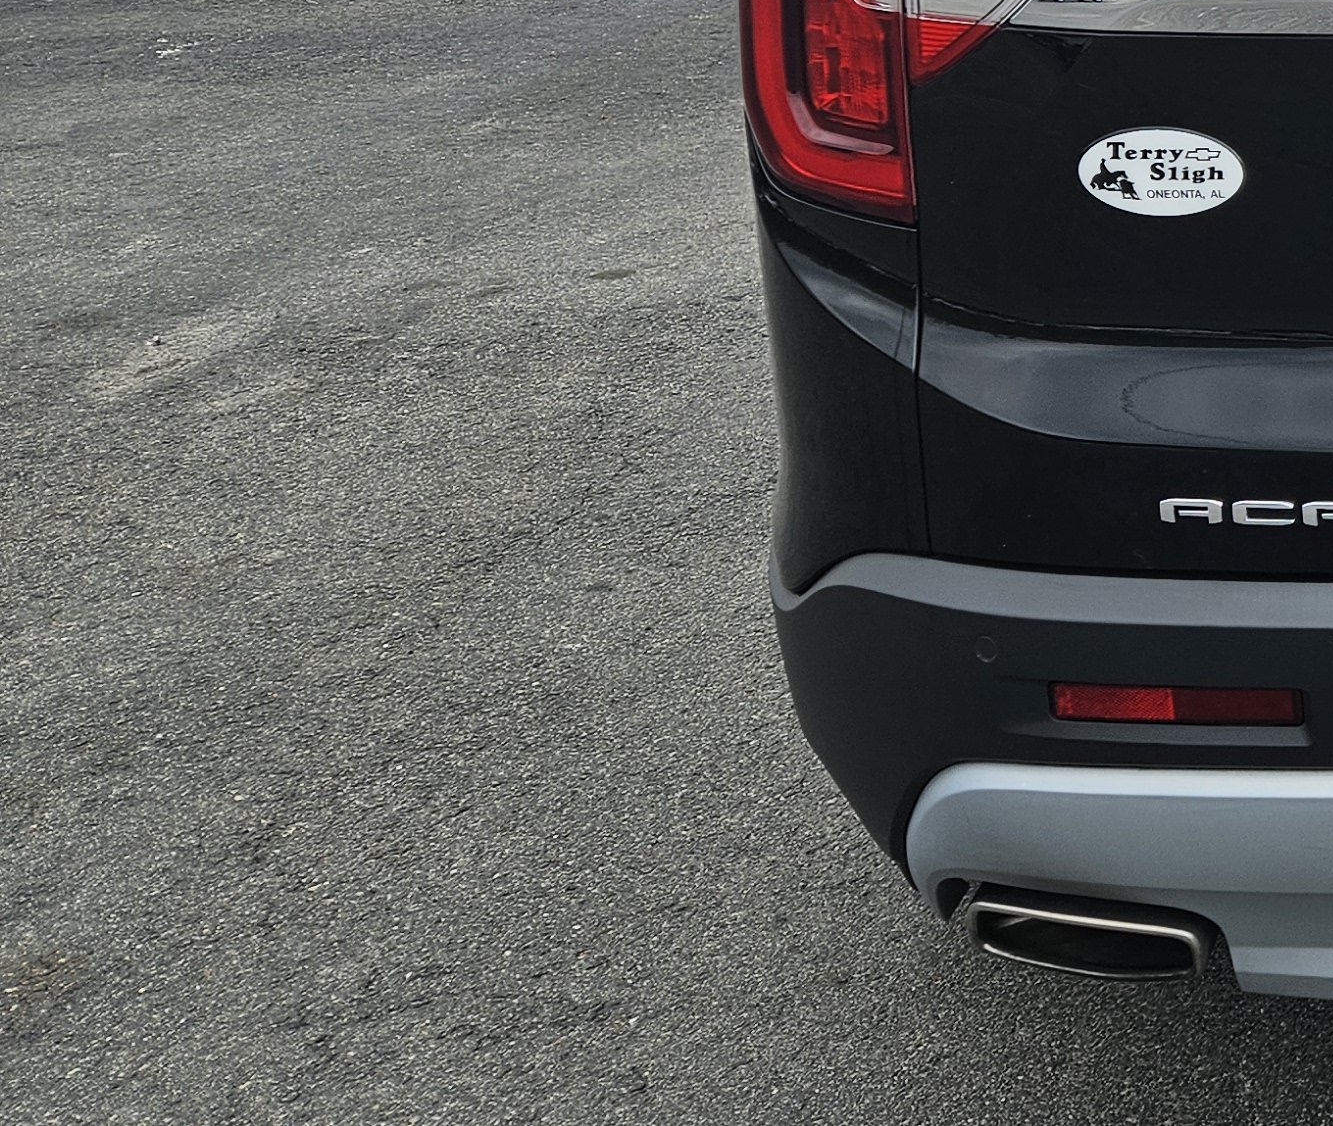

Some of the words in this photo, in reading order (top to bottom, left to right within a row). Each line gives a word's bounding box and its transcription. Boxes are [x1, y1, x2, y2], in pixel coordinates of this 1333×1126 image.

[1106, 141, 1184, 163] Terry
[1149, 162, 1225, 184] Sligh
[1146, 189, 1206, 200] ONEONTA,
[1210, 189, 1225, 199] AL
